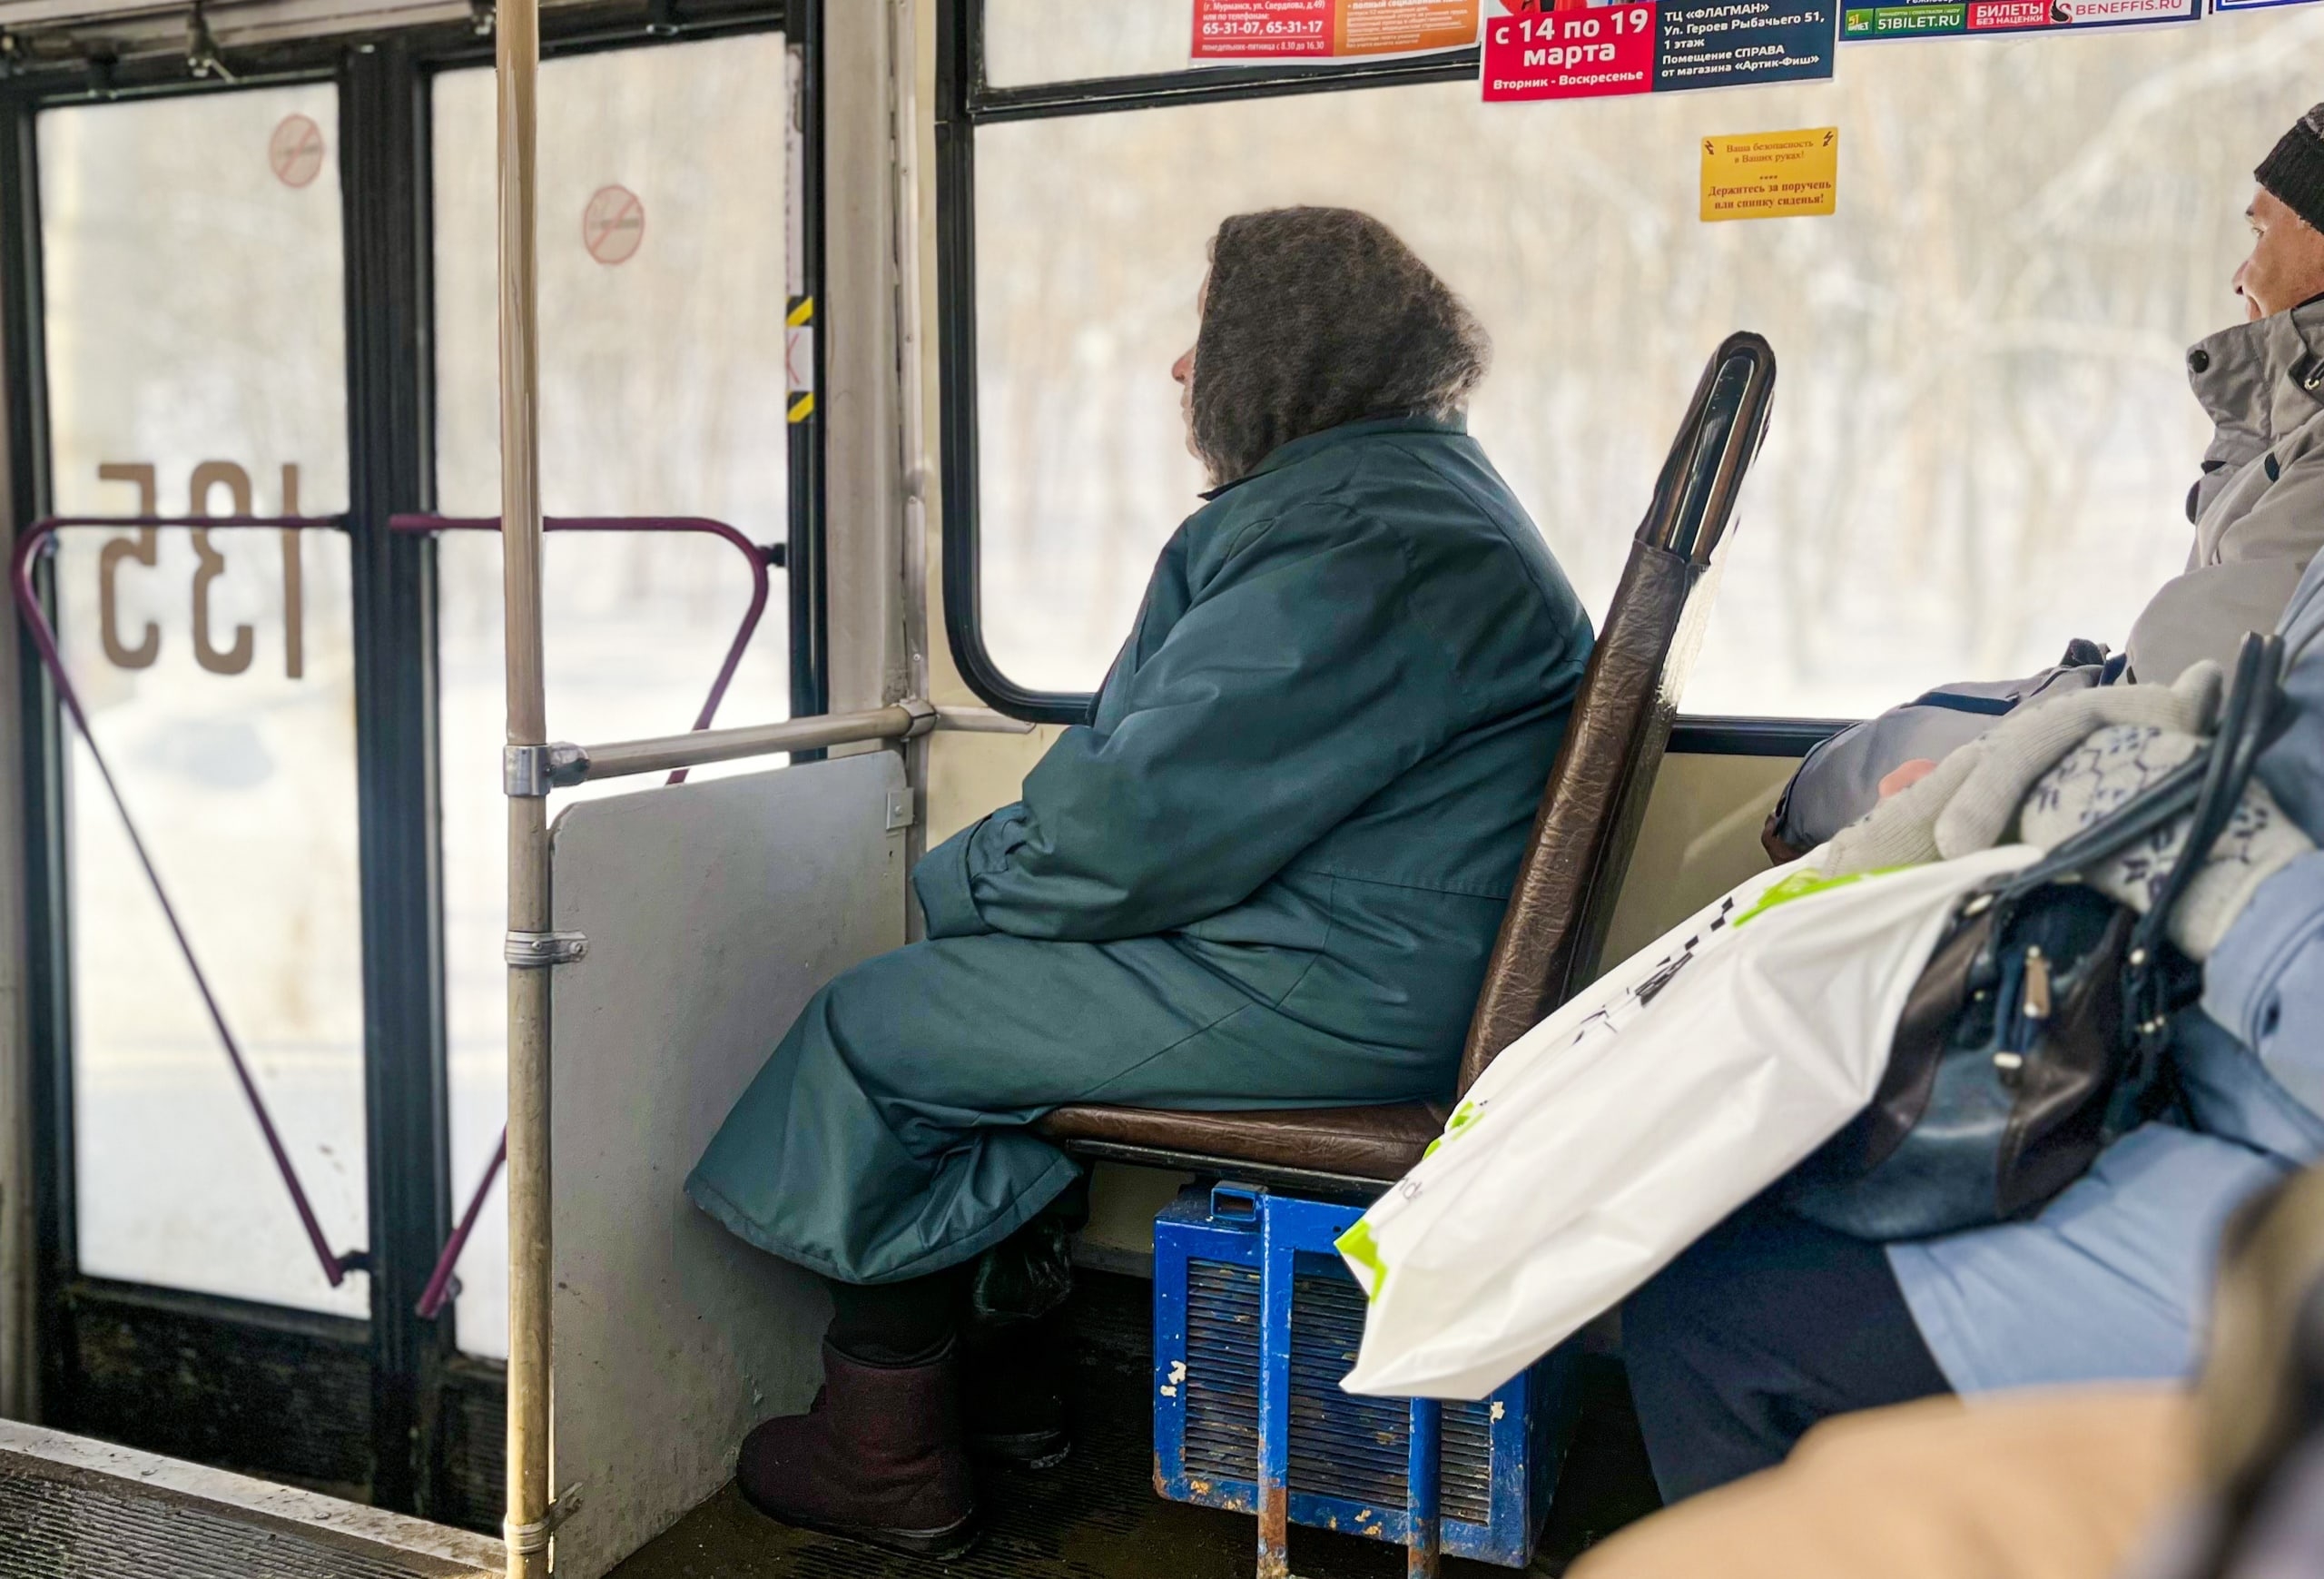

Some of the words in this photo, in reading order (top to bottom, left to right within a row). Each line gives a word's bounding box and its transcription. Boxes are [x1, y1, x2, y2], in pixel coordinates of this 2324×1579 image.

[1664, 12, 1683, 23] ТЦ
[1686, 3, 1770, 19] «ФЛАГМАН»
[1976, 3, 2043, 17] БИЛЕТЫ
[2075, 0, 2182, 15] BENEFFIS.RU
[1203, 21, 1263, 35] 65-31-07,
[1266, 20, 1323, 34] 65-31-17
[1495, 26, 1510, 44] с
[1519, 18, 1555, 43] 14
[1564, 19, 1600, 39] по
[1610, 9, 1649, 35] 19
[1664, 26, 1683, 35] Ул.
[1687, 23, 1728, 35] Героев
[1731, 15, 1801, 30] Рыбачьего
[1804, 12, 1825, 23] 51,
[1877, 15, 1960, 30] 51BILET.RU
[1976, 17, 1994, 25] БЕЗ
[1996, 15, 2043, 25] НАЦЕНКИ
[1664, 40, 1670, 50] 1
[1674, 39, 1705, 48] этаж
[1523, 43, 1616, 69] марта
[1662, 50, 1732, 64] Помещение
[1735, 44, 1785, 58] СПРАВА
[1661, 68, 1675, 77] от
[1678, 64, 1731, 75] магазина
[1735, 55, 1819, 72] «Артик-Фиш»
[1493, 78, 1548, 90] Вторник
[1559, 71, 1644, 87] Воскресенье
[1727, 144, 1751, 153] Ваша
[1753, 141, 1814, 152] безопасность
[1742, 154, 1773, 163] Ваших
[1775, 151, 1805, 163] руках!
[1708, 185, 1765, 197] Держитесь
[1781, 181, 1831, 194] поручень
[1715, 202, 1734, 210] или
[1737, 199, 1774, 209] спинку
[1777, 193, 1825, 205] сиденья!
